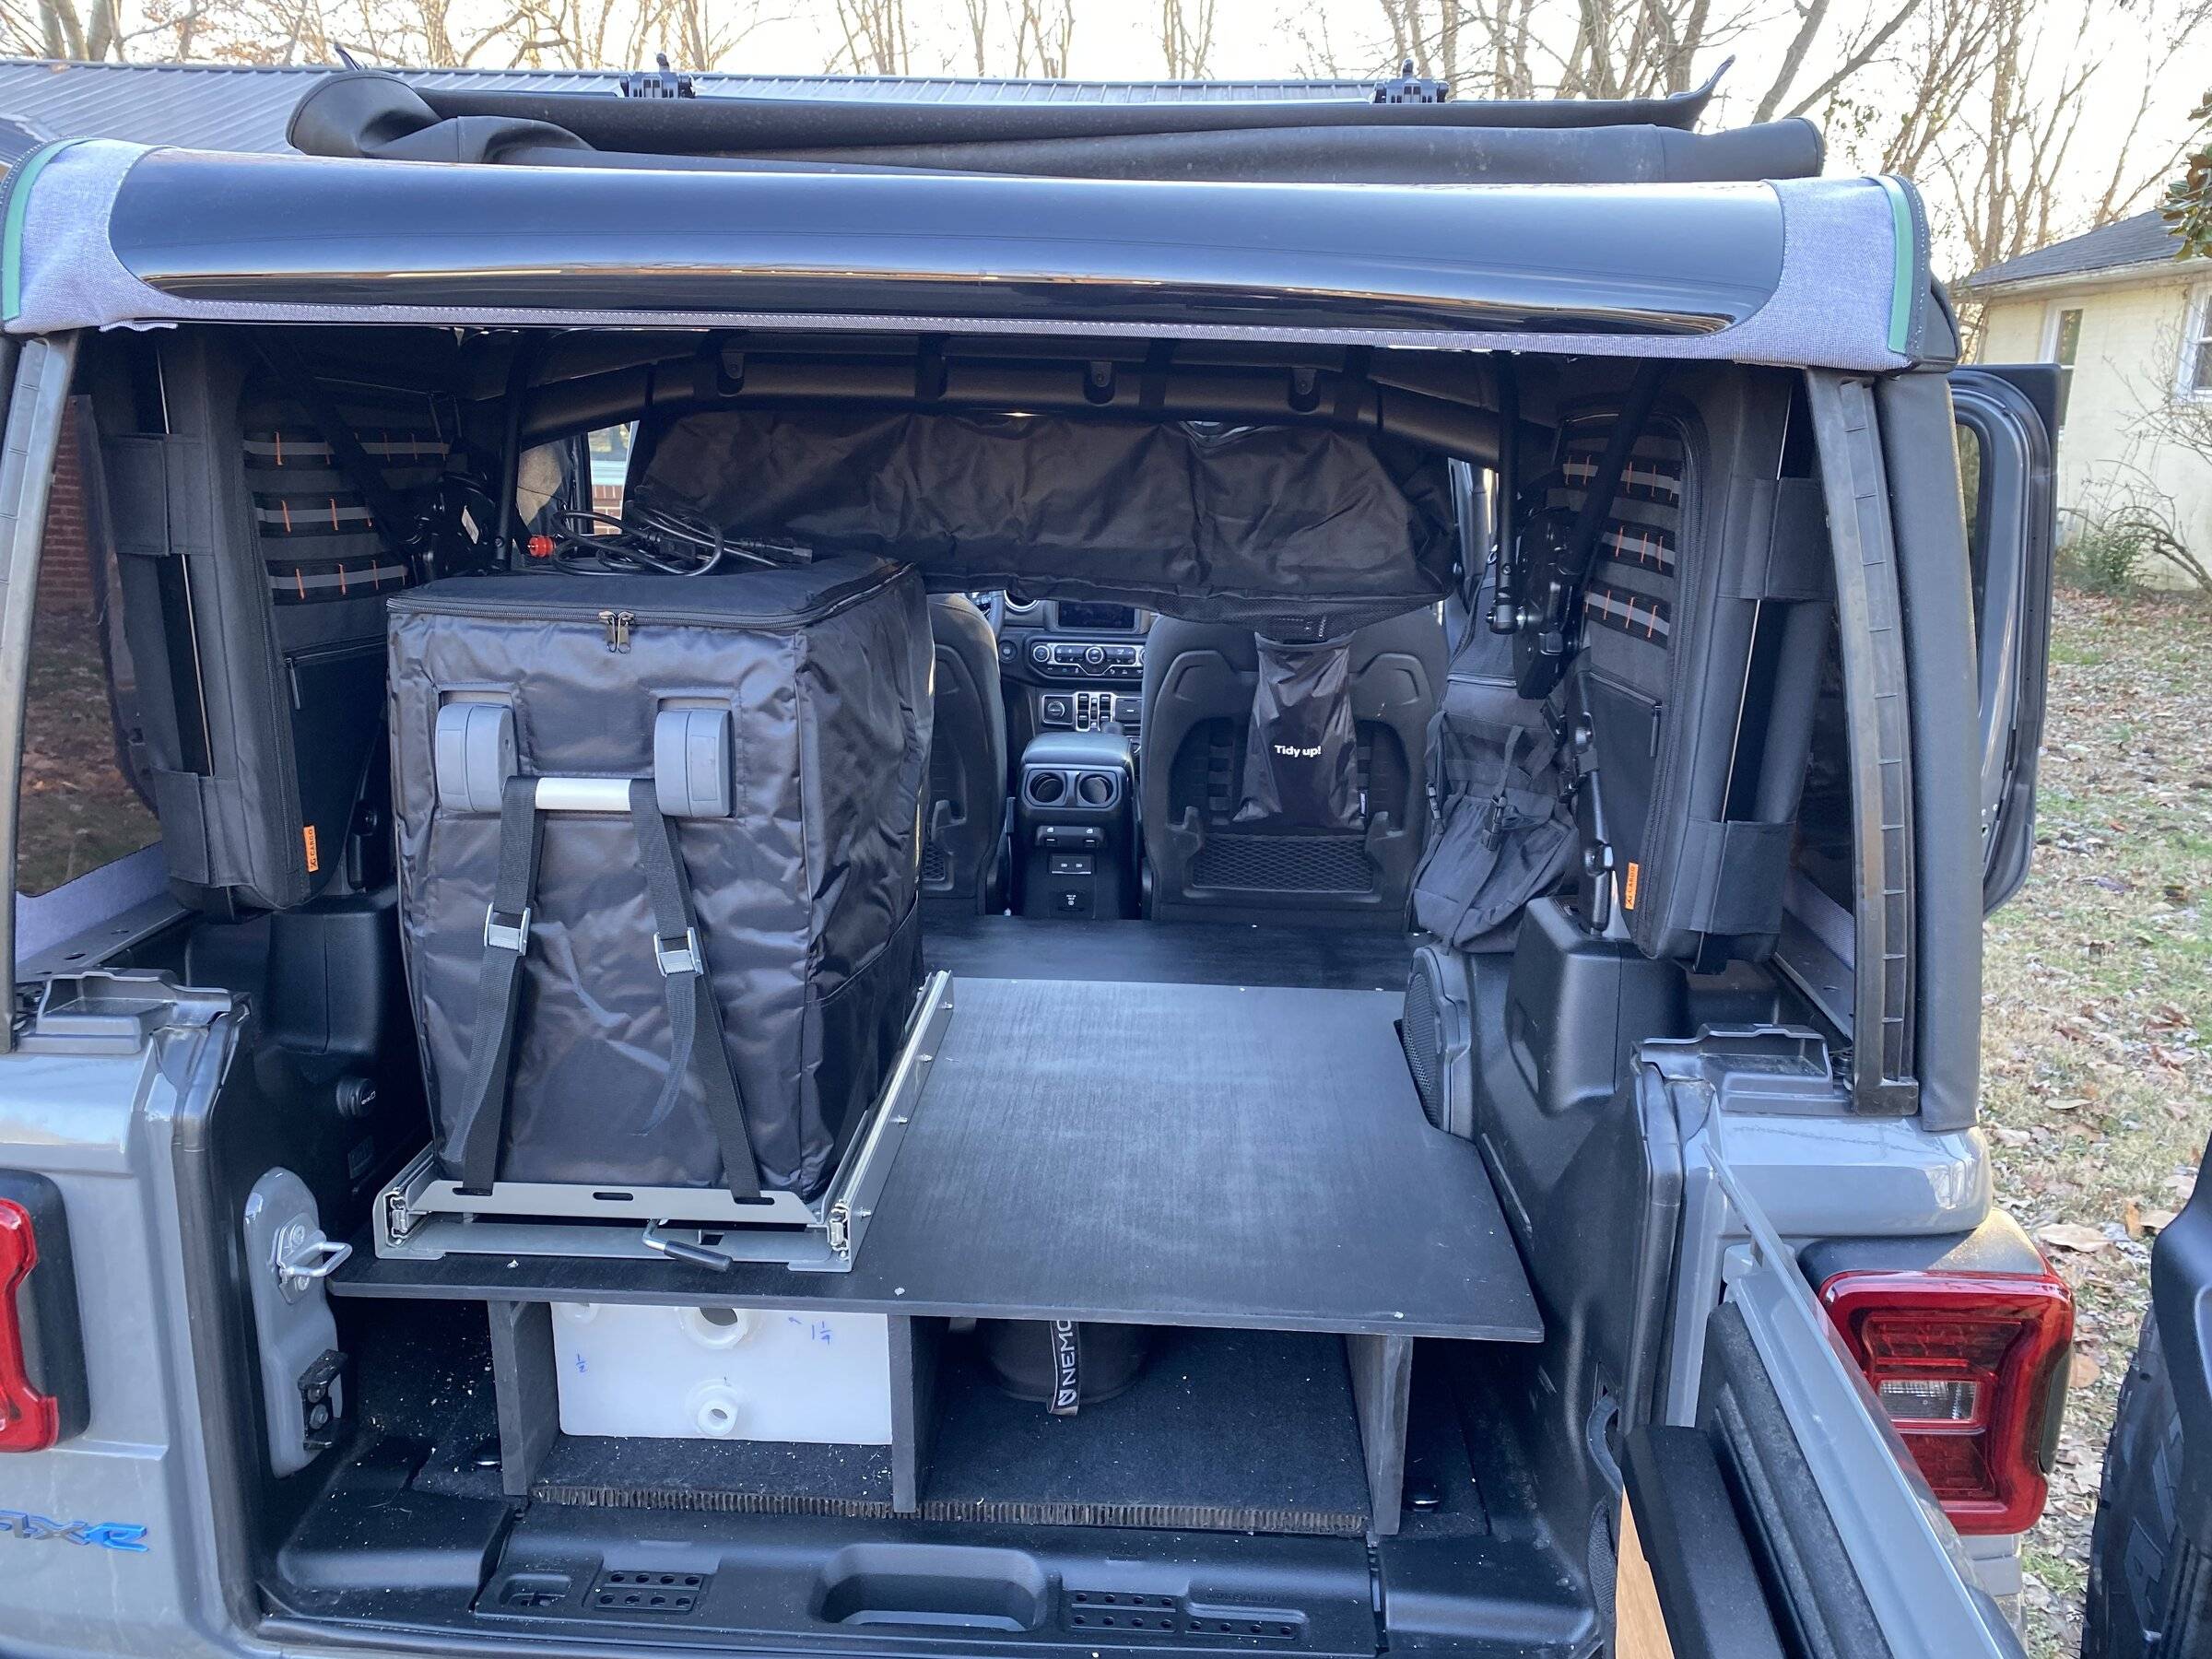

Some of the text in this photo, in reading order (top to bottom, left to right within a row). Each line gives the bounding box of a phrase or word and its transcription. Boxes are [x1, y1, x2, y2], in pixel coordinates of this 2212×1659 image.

[1274, 745, 1322, 758] Tidy up!
[308, 829, 316, 856] CARGO
